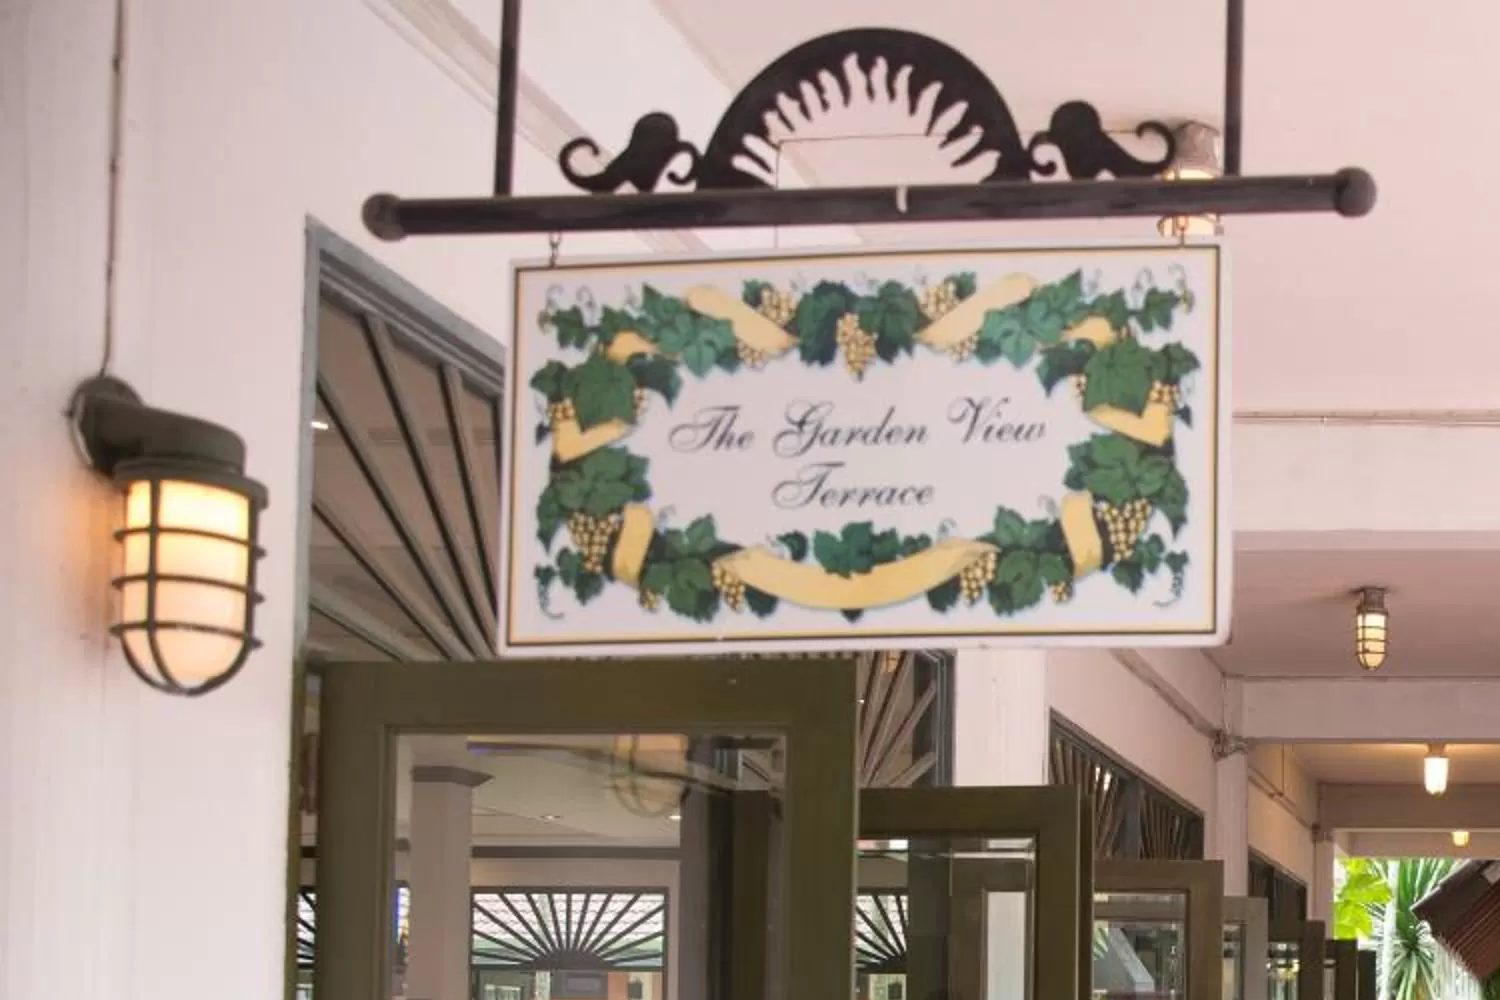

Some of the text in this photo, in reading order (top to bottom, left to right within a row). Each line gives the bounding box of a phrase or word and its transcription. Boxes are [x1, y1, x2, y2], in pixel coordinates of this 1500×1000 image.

[668, 396, 1046, 459] The Garden View
[771, 460, 934, 511] Terrace
